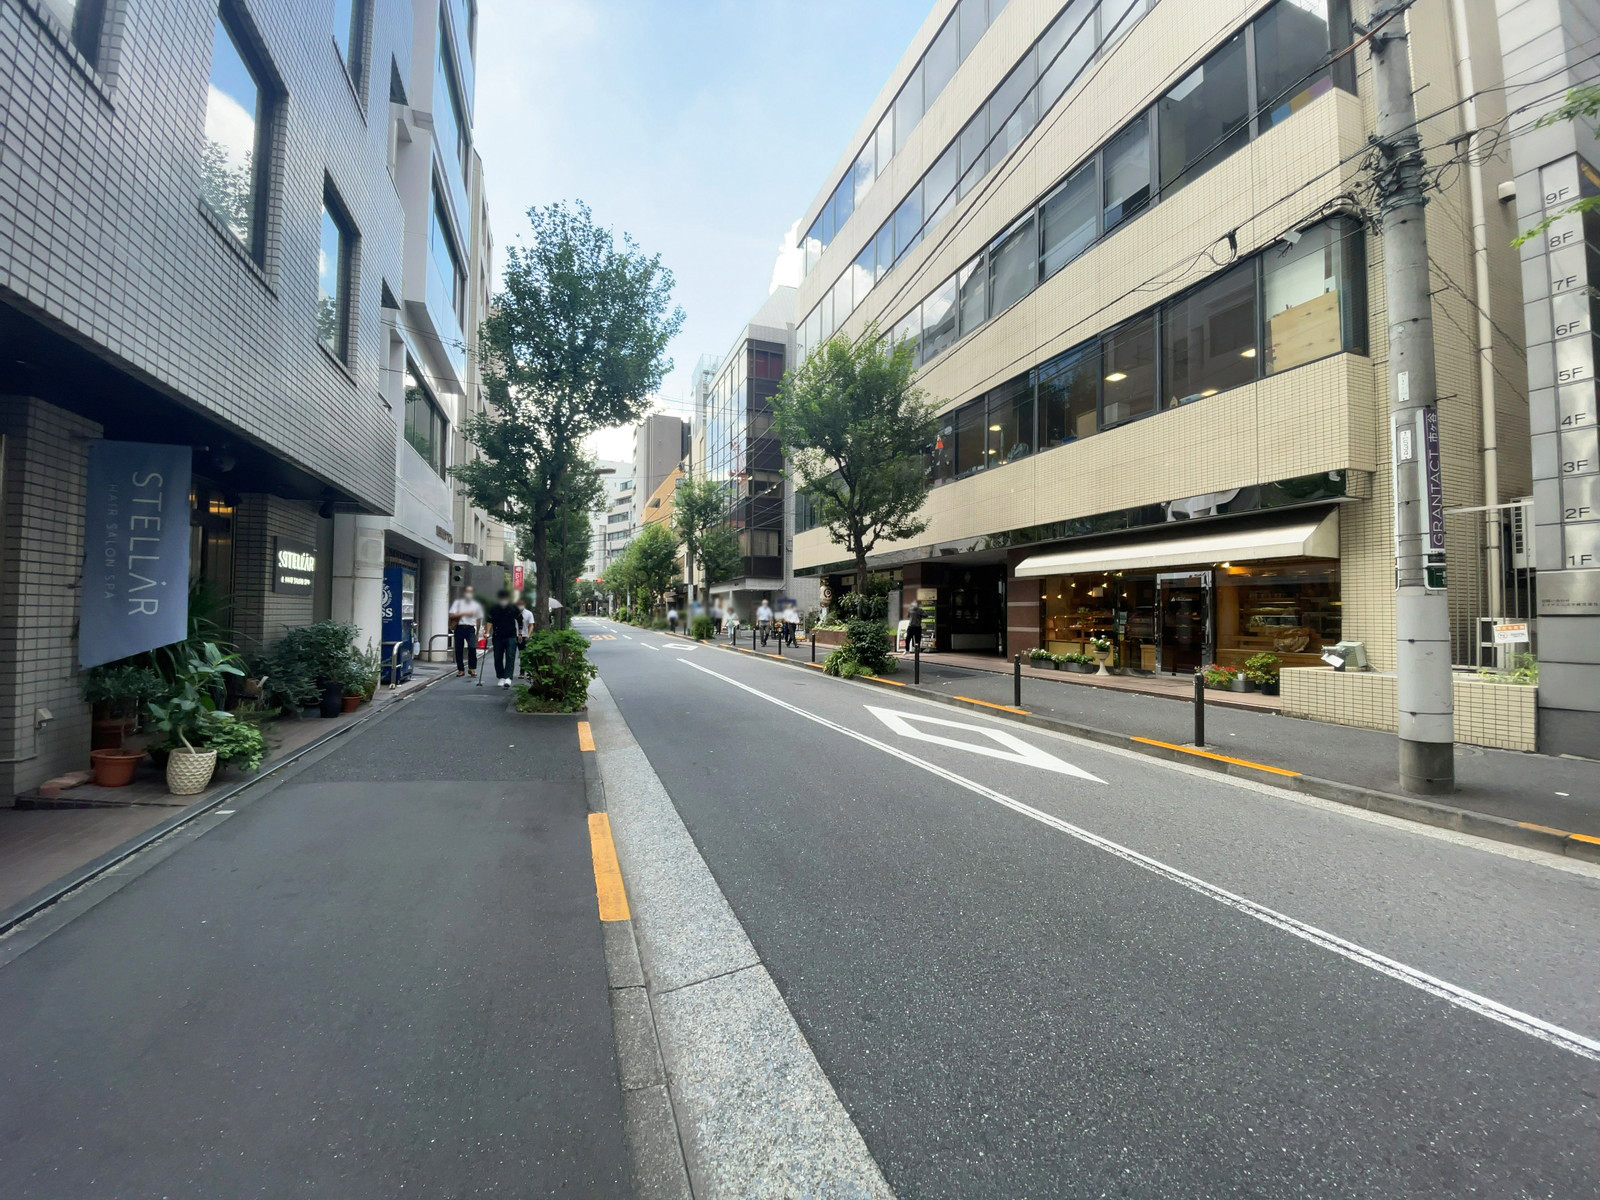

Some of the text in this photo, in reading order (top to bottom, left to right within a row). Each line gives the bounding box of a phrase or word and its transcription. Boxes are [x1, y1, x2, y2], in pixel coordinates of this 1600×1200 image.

[1546, 187, 1569, 204] 9F
[1550, 231, 1574, 248] 8F
[1553, 275, 1577, 291] 7F
[1556, 321, 1581, 336] 6F
[1559, 367, 1584, 381] 5F
[1561, 413, 1586, 426] 4F
[1563, 460, 1588, 473] 3F
[1429, 449, 1444, 546] GRANTACT
[1565, 507, 1590, 519] 2F
[104, 484, 118, 599] HAIR SALON SPA
[1568, 554, 1592, 566] 1F
